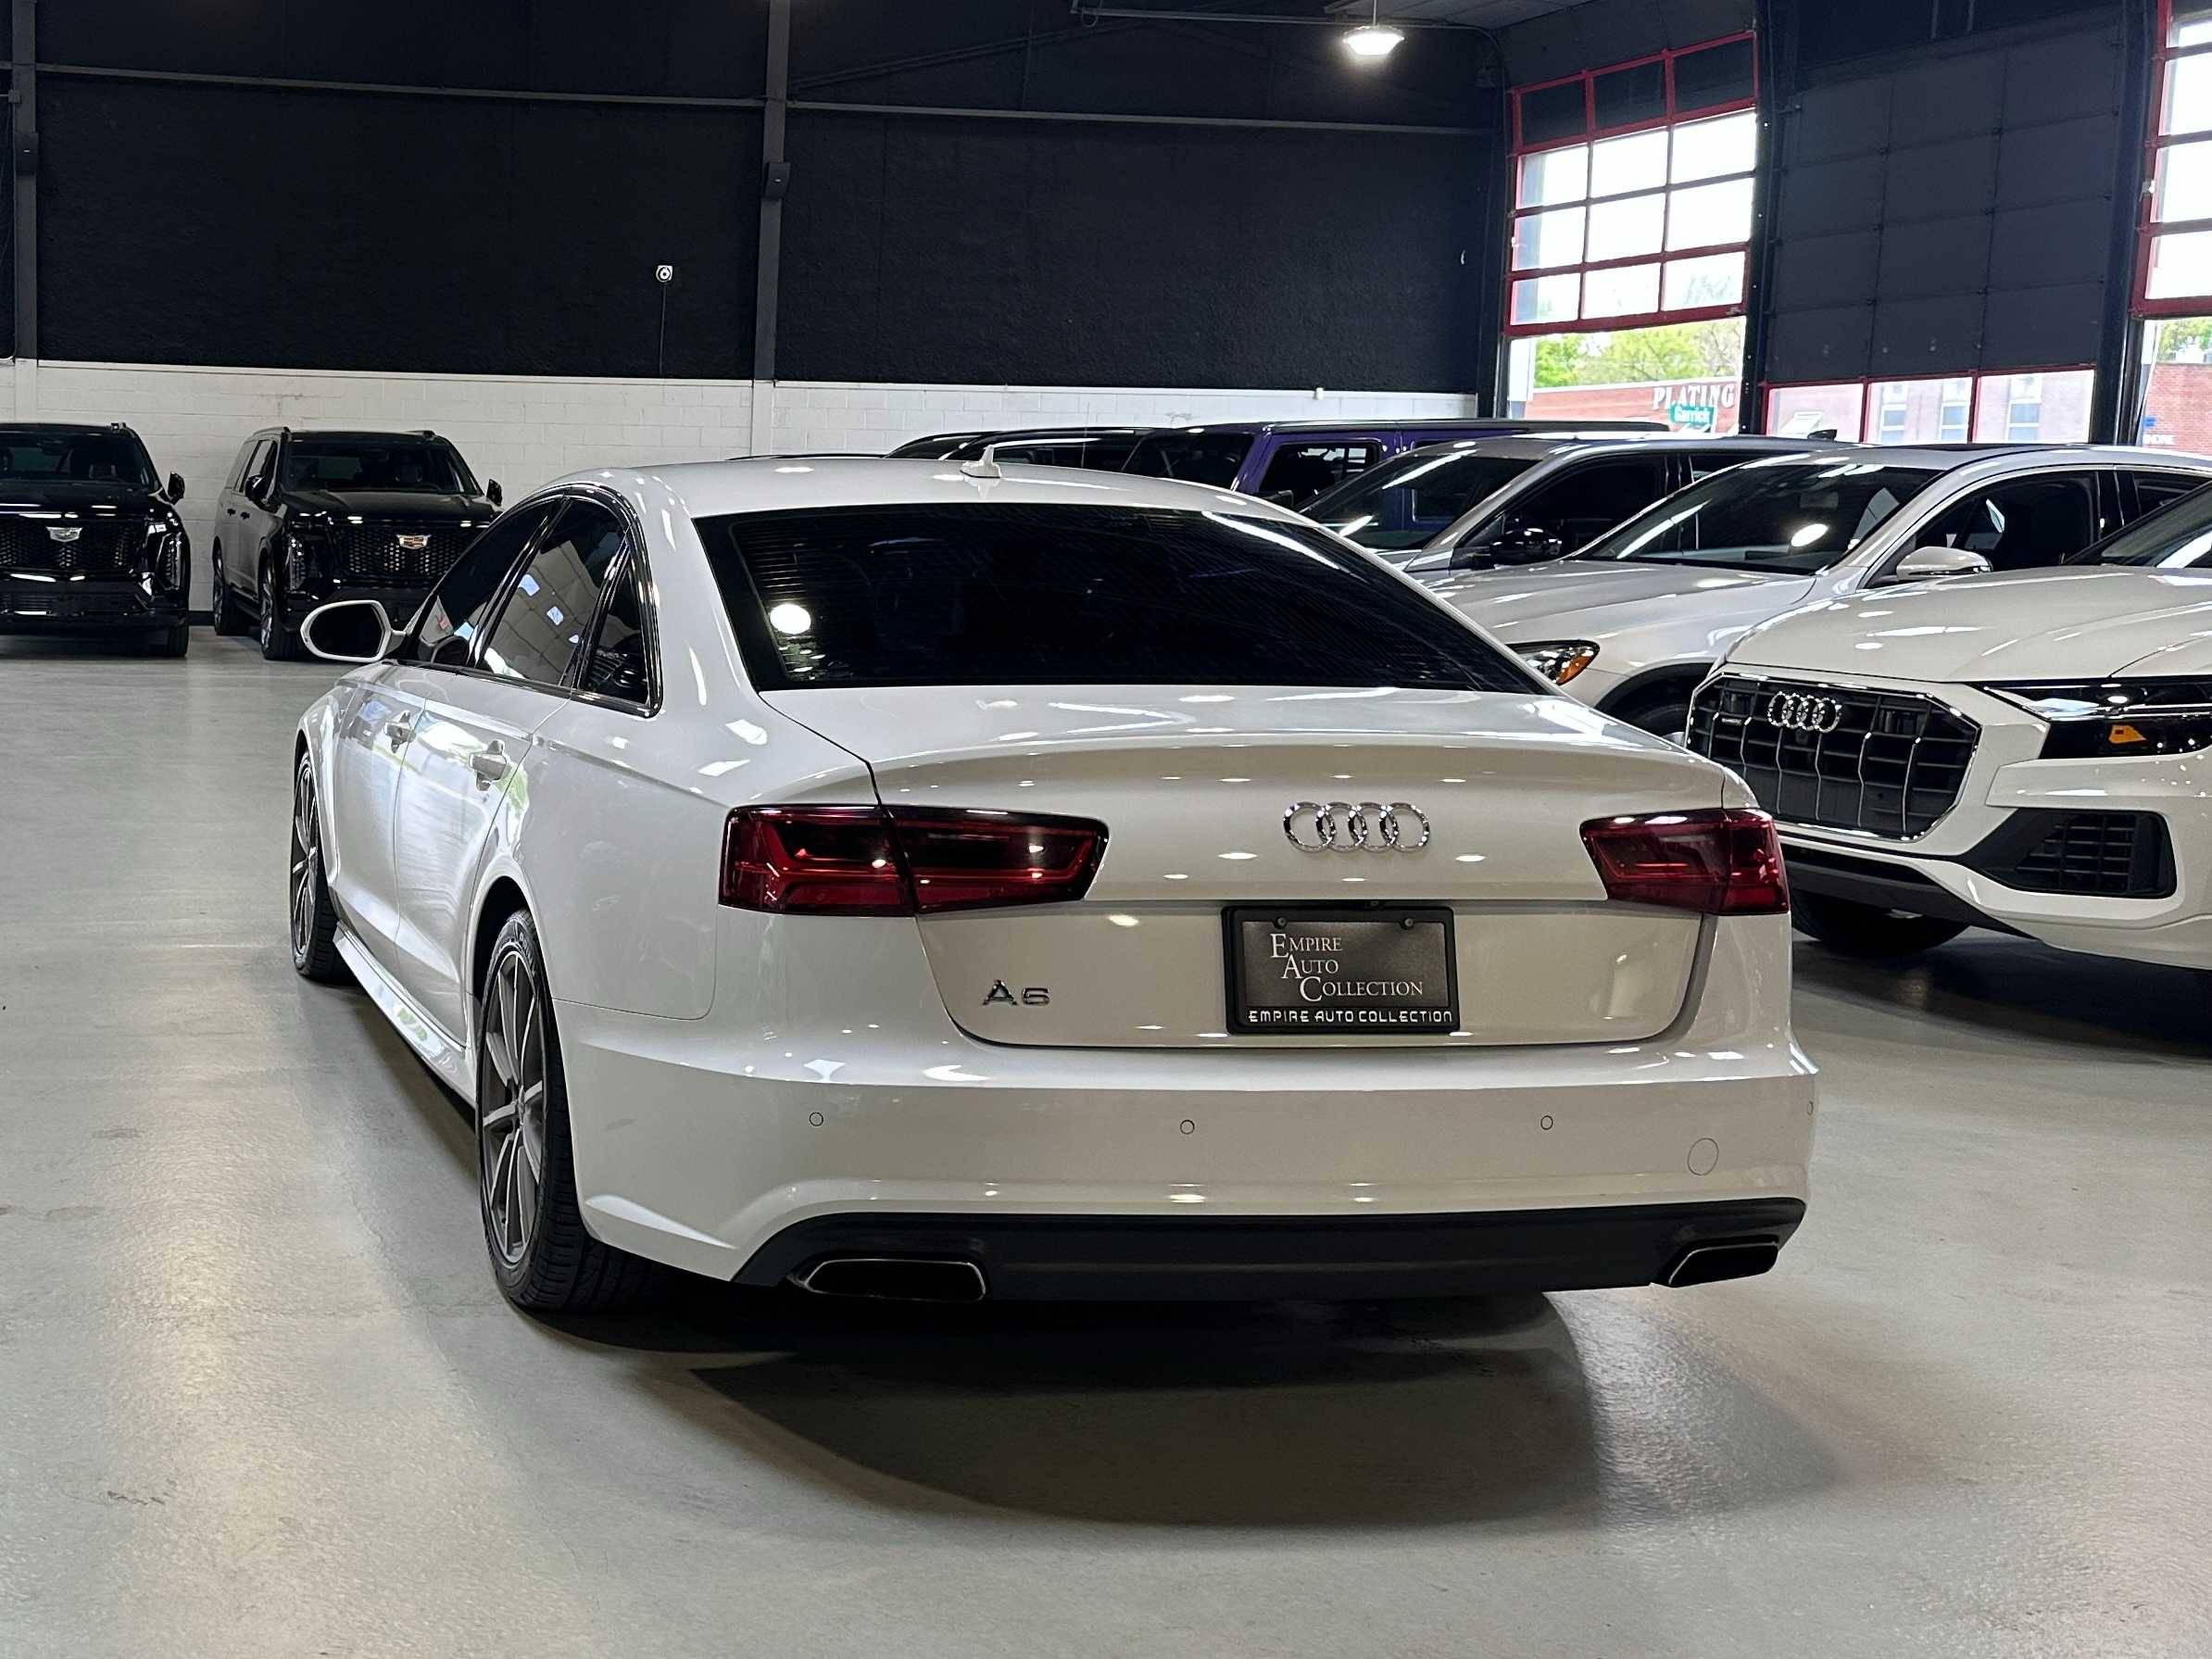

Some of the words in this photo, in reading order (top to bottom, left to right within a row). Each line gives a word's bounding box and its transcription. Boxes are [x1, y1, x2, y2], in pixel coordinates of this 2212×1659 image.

[1652, 383, 1735, 410] PLATING
[1270, 933, 1343, 958] EMPIRE
[1281, 954, 1339, 978] AUTO
[982, 979, 1050, 1006] A6
[1300, 976, 1424, 1002] COLLECTION
[1249, 1010, 1310, 1024] EMPIRE
[1313, 1010, 1354, 1024] AUTO
[1358, 1010, 1452, 1024] COLLECTION
